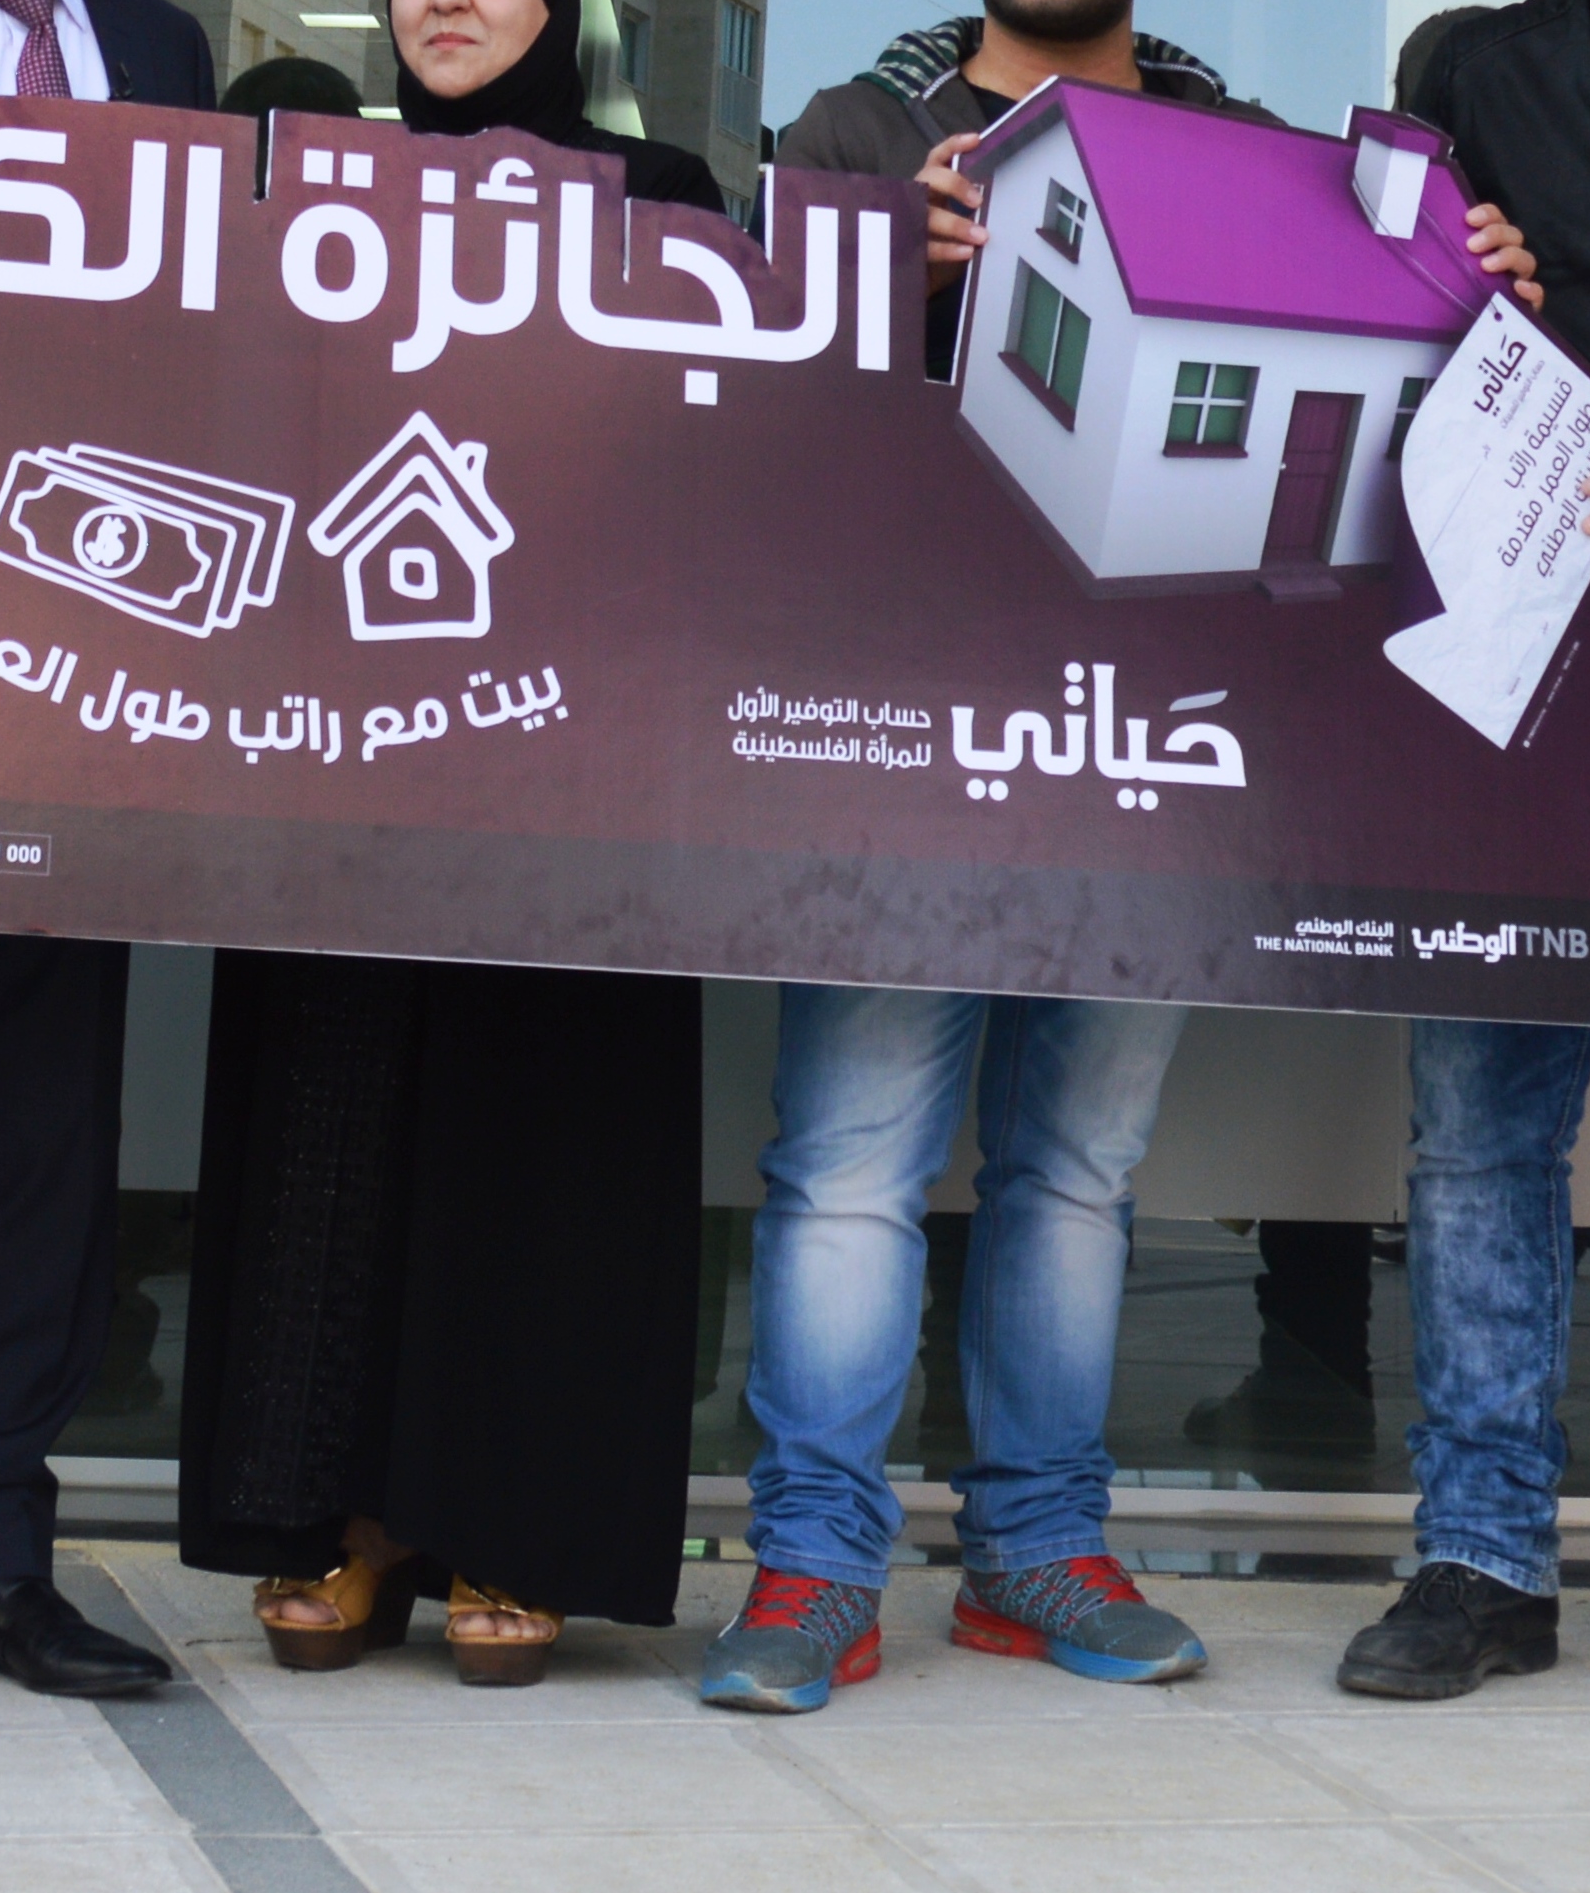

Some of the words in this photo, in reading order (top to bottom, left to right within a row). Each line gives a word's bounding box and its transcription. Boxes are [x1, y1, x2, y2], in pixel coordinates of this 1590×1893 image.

[280, 148, 892, 406] الجائزة
[1524, 377, 1574, 450] قسيمة
[1505, 450, 1537, 489] راتب
[1539, 441, 1574, 503] العمر
[1497, 500, 1543, 567] مقدمة
[1538, 499, 1579, 578] الوطني
[79, 670, 211, 744] طول
[460, 666, 570, 733] بيت
[726, 685, 781, 724] الأول
[782, 694, 859, 728] التوفير
[862, 701, 933, 732] حساب
[227, 695, 342, 764] راتب
[361, 697, 450, 763] مع
[730, 730, 862, 764] الفلسطينية
[865, 739, 933, 771] للمرأة
[6, 844, 43, 865] 000
[1253, 935, 1282, 952] THE
[1283, 937, 1353, 956] NATIONAL
[1354, 940, 1394, 957] BANK
[1294, 916, 1354, 938] الوطني
[1355, 920, 1395, 939] البنك
[1411, 920, 1518, 964] الوطني
[1518, 925, 1590, 960] TNB
